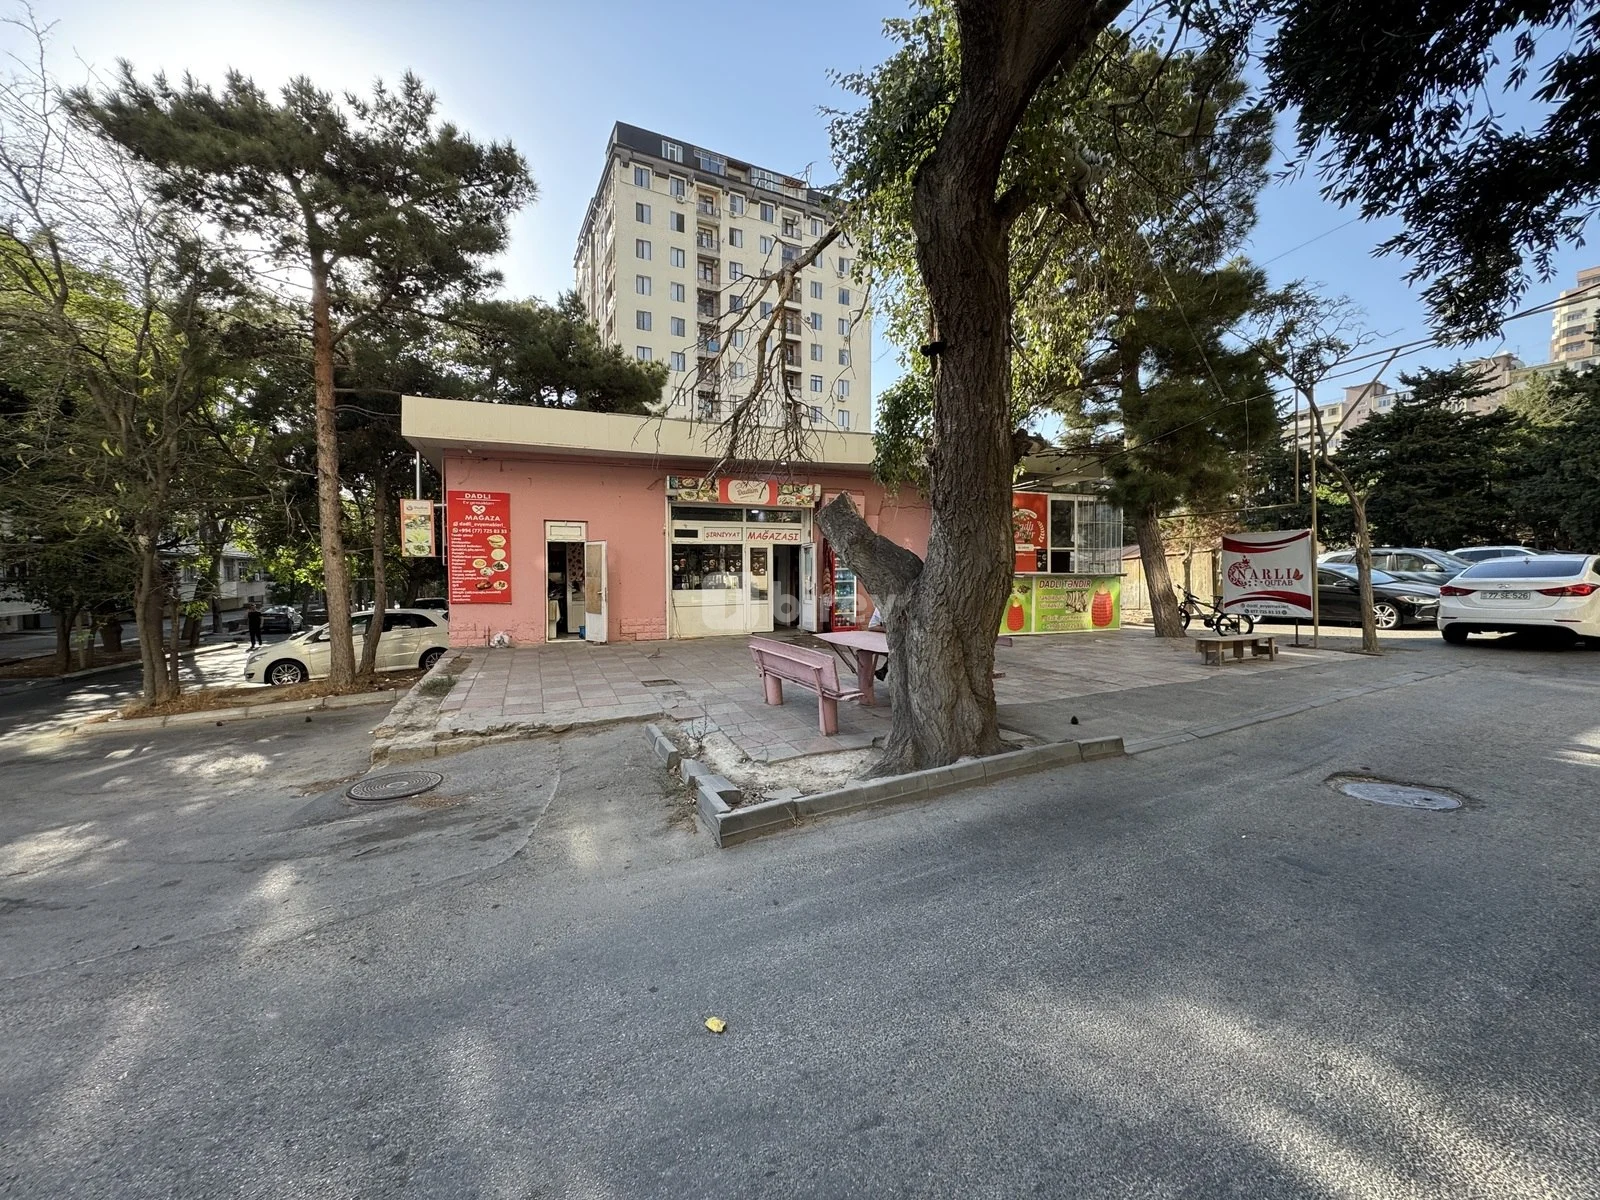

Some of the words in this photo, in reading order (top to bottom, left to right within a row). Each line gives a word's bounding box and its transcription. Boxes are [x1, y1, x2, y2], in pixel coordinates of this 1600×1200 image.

[464, 492, 491, 500] DADLI
[747, 529, 800, 542] MAĞAZASI
[1236, 567, 1292, 579] NARLI
[1039, 579, 1062, 589] DADLI
[1264, 579, 1294, 587] QUTAB
